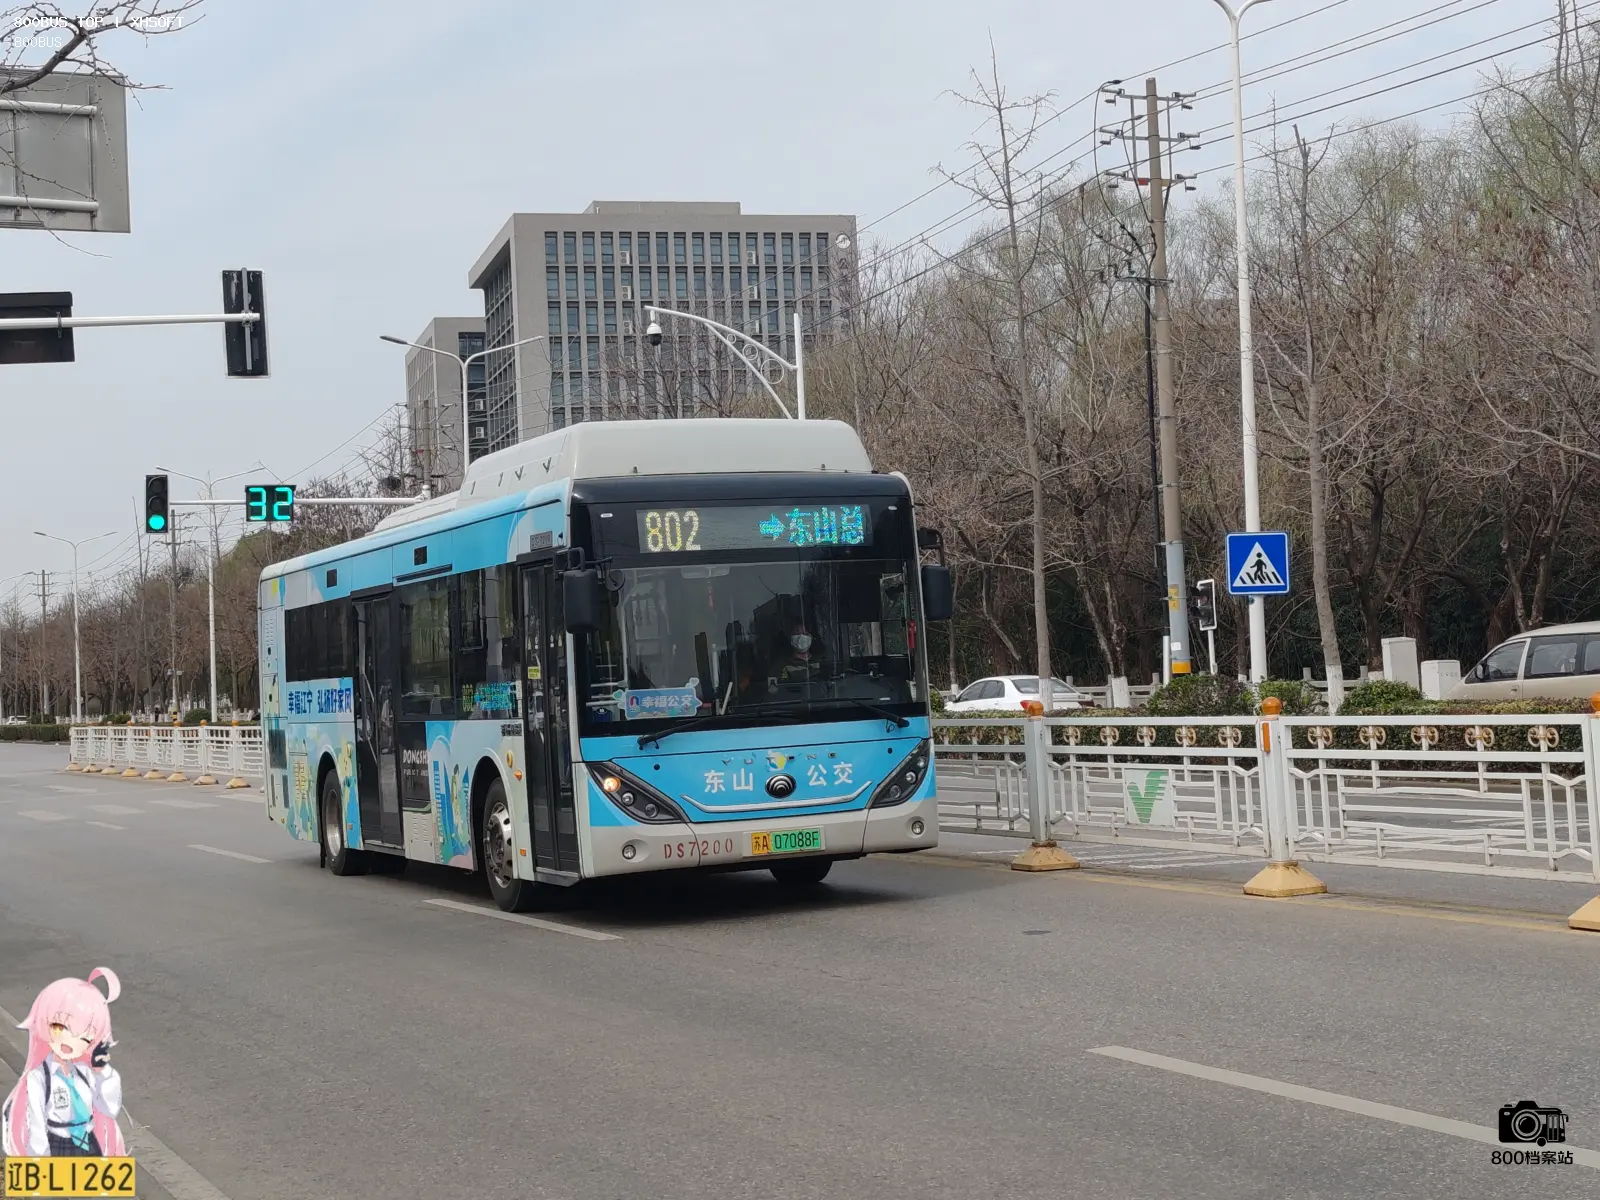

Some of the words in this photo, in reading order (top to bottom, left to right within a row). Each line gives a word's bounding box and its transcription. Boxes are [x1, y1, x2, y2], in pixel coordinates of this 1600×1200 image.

[249, 487, 293, 520] 32
[645, 510, 701, 552] 802
[288, 689, 313, 715] 幸福江宁
[641, 694, 693, 708] 幸福公交
[703, 767, 754, 794] 东山
[807, 761, 853, 787] 公交
[663, 837, 733, 860] DS7200
